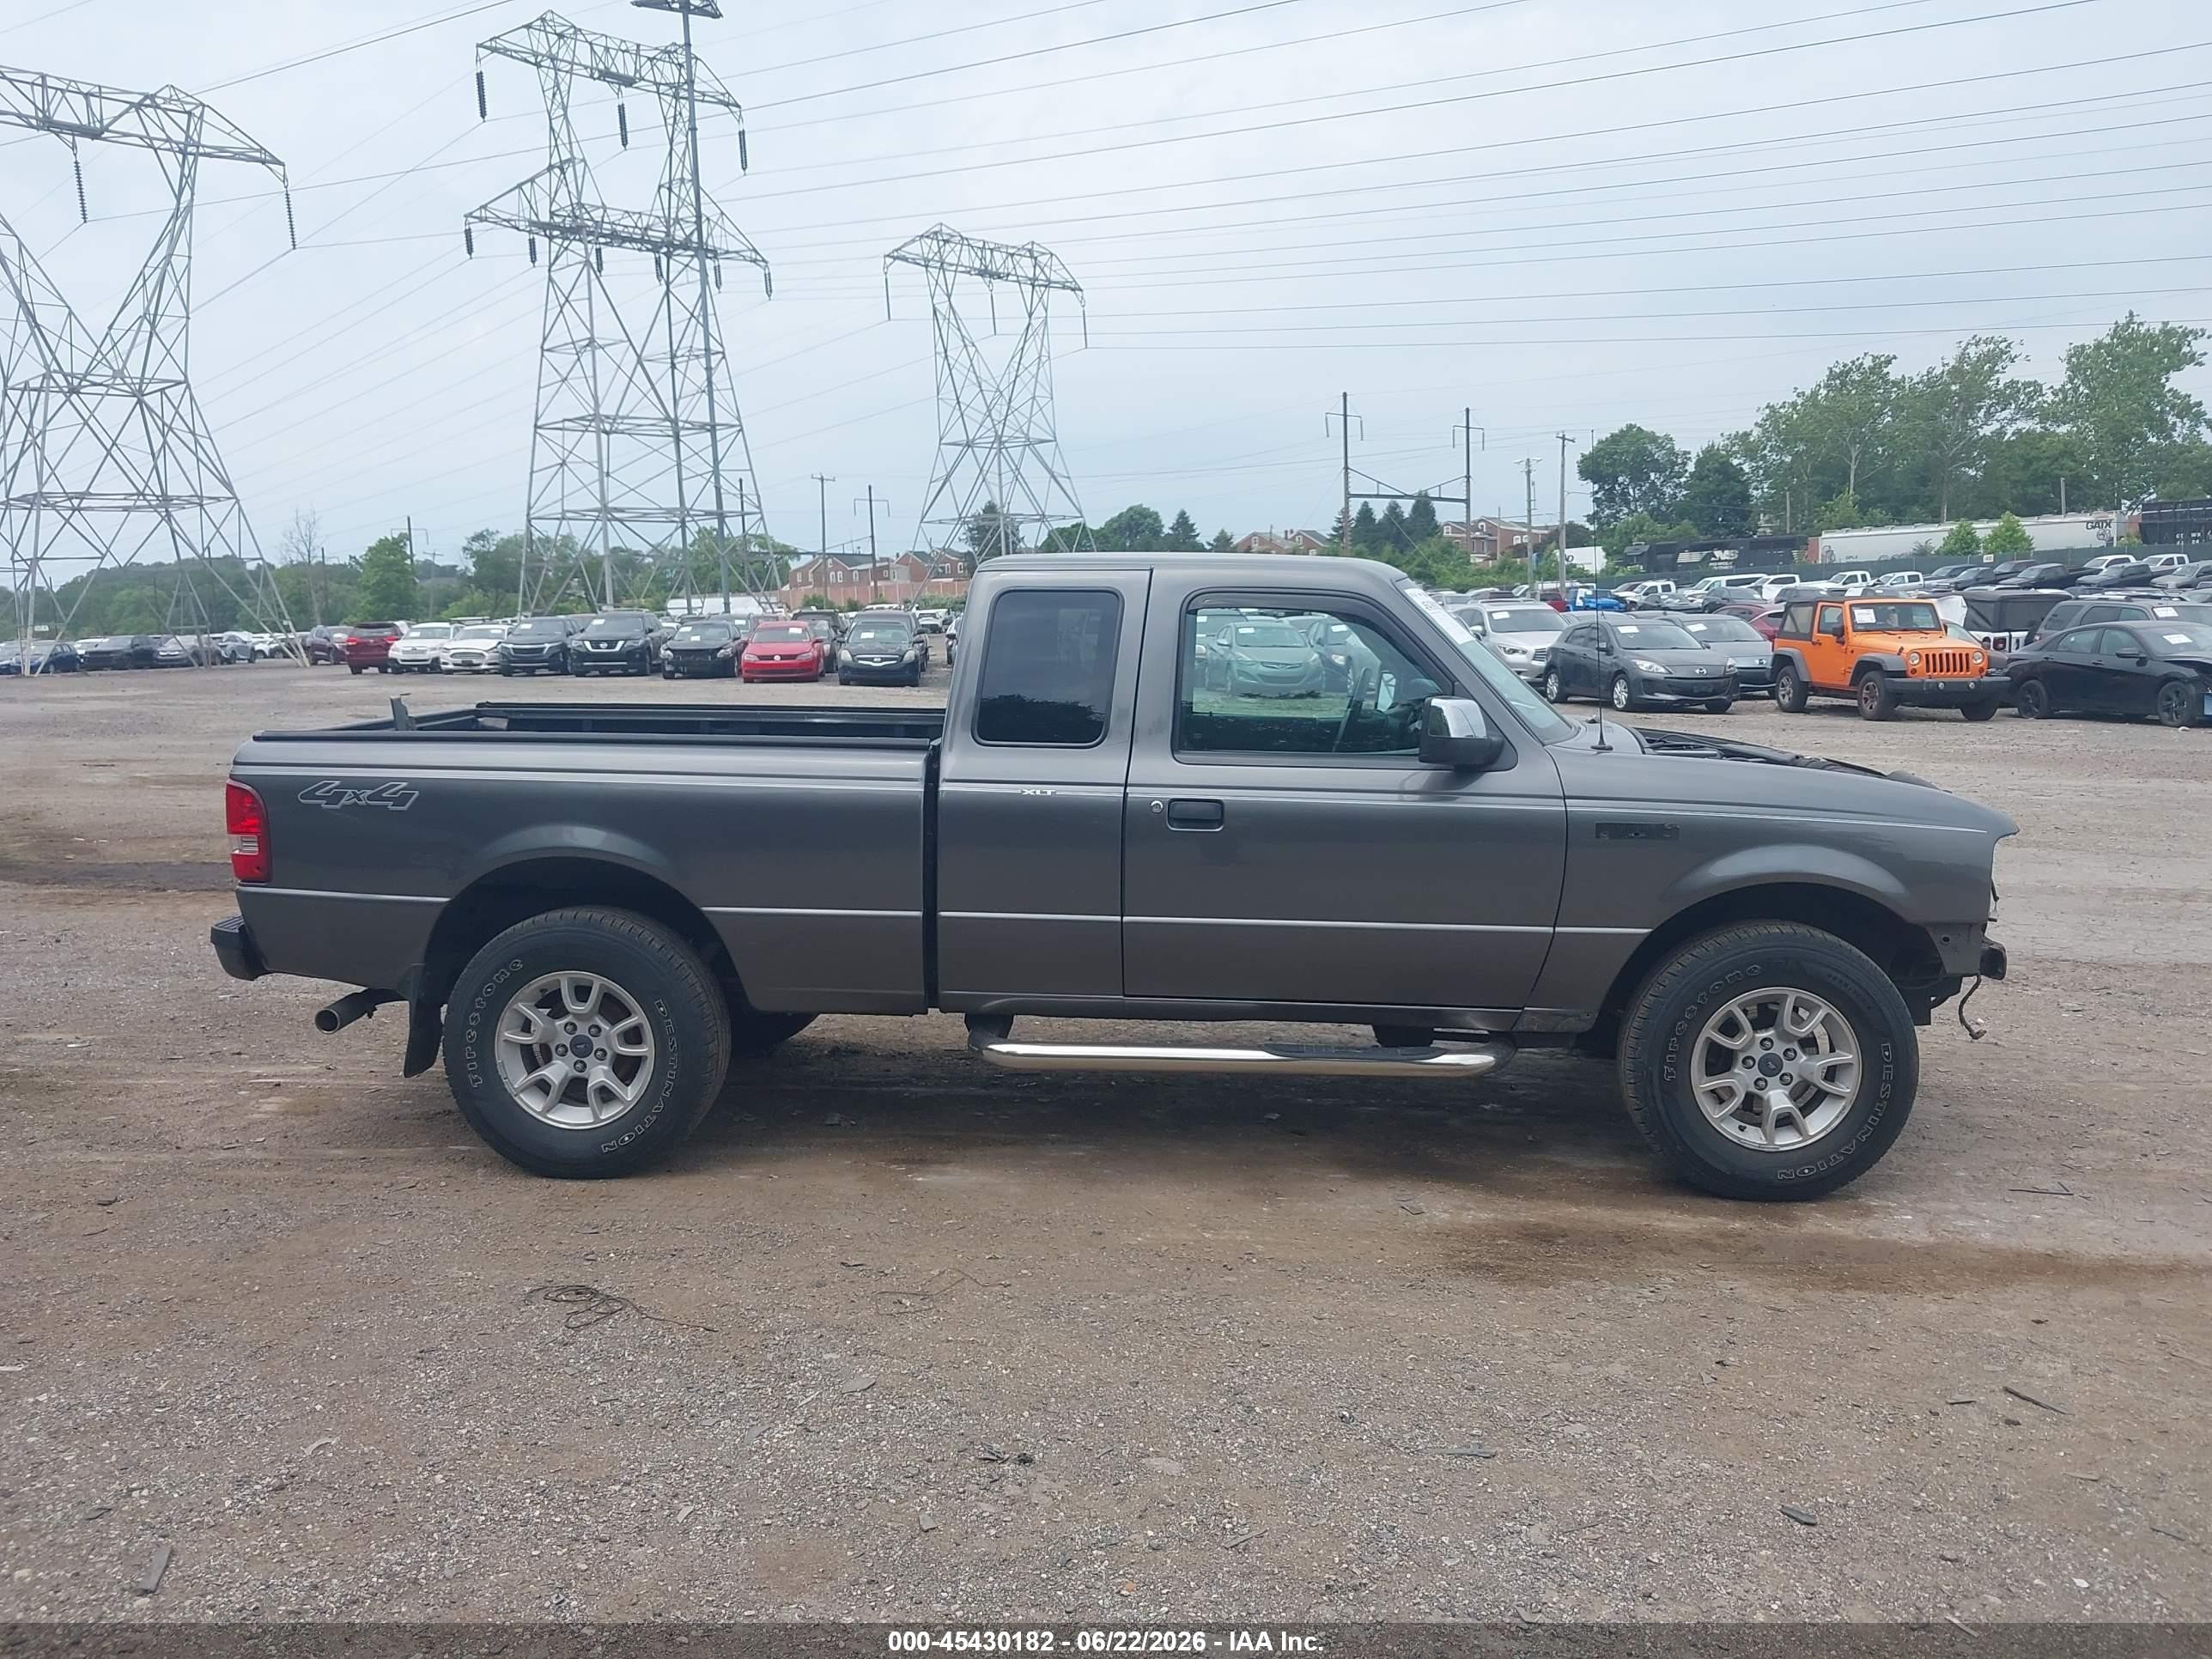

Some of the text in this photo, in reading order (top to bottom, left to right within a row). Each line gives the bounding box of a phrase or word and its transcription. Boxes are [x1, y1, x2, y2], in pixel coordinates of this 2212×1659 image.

[2086, 520, 2112, 530] GATX
[298, 780, 420, 811] 4x4
[601, 999, 679, 1154] DESTINATION
[1778, 1042, 1894, 1181] DESTINATION
